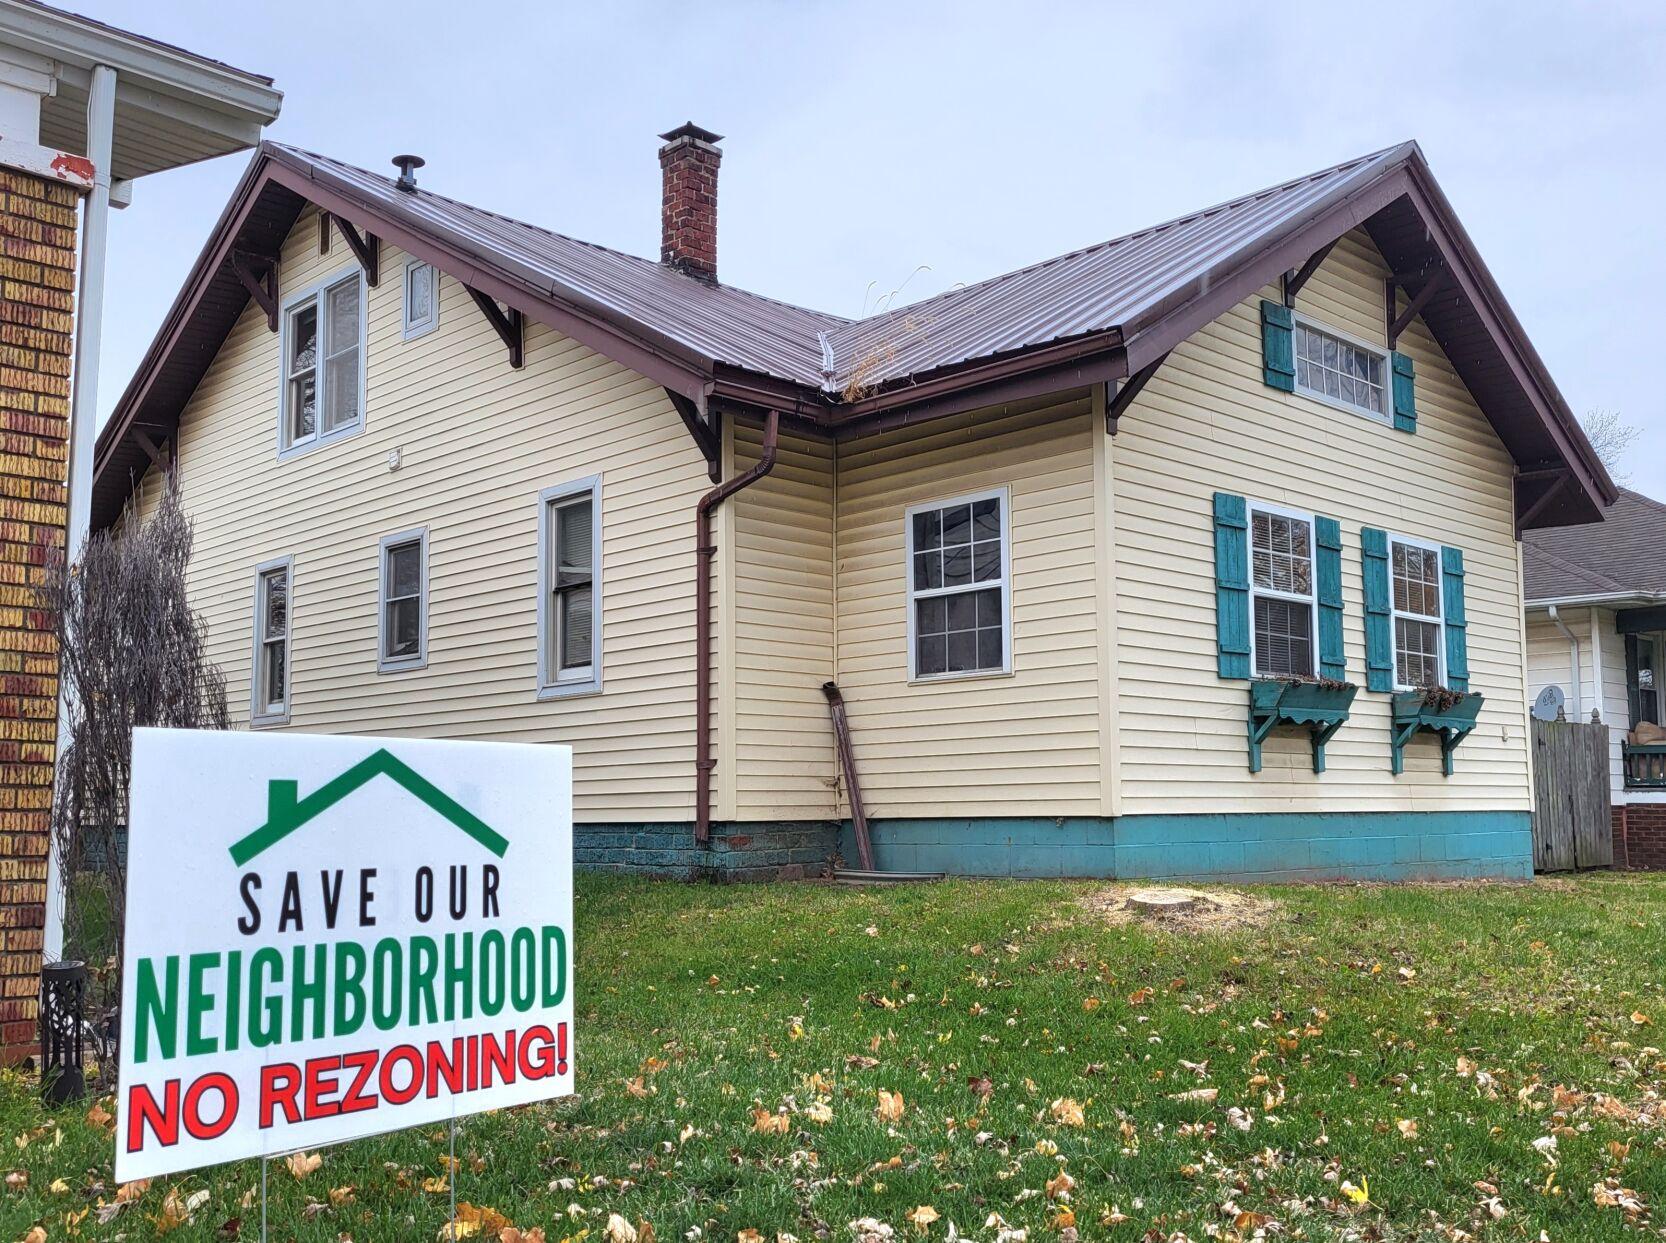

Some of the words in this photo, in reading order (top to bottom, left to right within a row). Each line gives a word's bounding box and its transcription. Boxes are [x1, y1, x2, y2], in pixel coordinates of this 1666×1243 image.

[237, 867, 378, 935] SAVE
[415, 864, 500, 923] OUR
[133, 925, 567, 1064] NEIGHBORHOOD
[126, 1072, 240, 1154] NO
[258, 1022, 569, 1129] REZONING!
